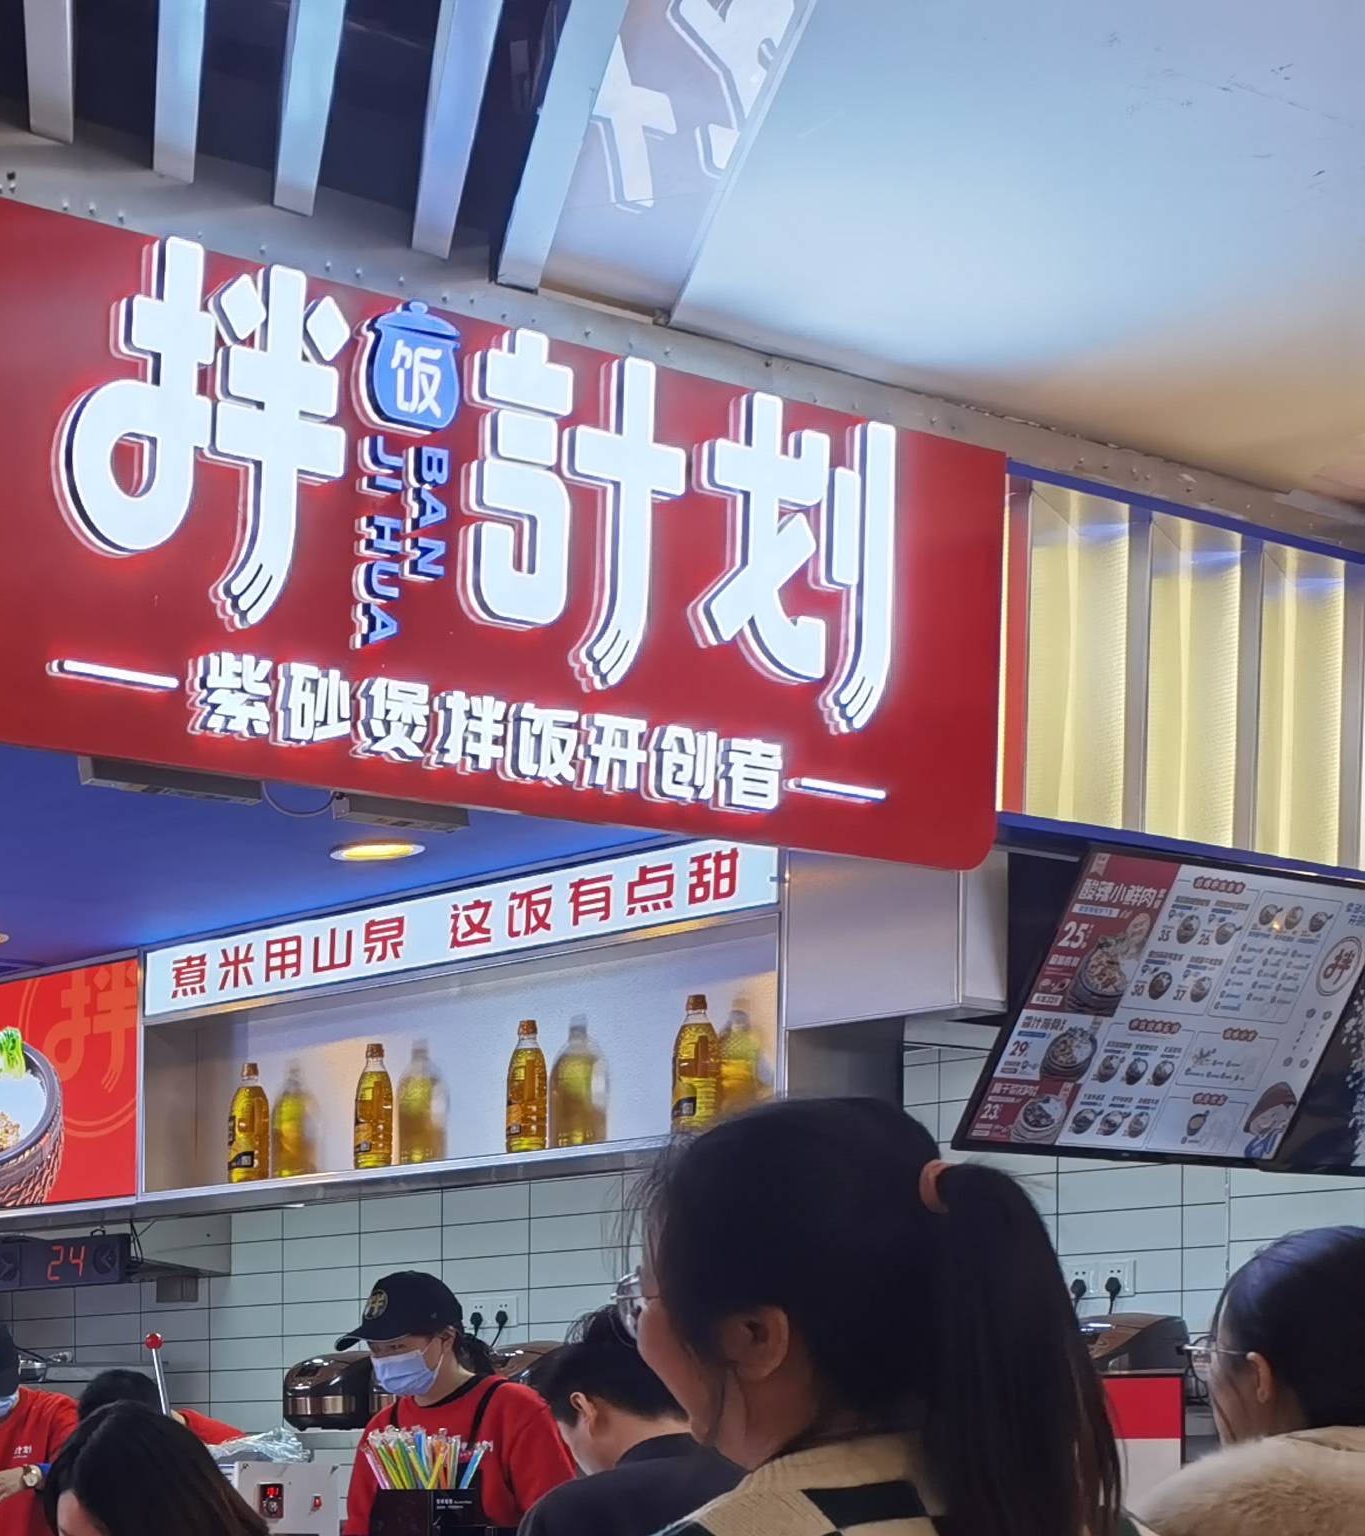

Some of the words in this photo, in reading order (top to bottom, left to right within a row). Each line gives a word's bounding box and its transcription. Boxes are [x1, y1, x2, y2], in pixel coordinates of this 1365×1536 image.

[406, 446, 445, 580] BAN
[191, 651, 784, 813] 紫砂煲拌饭开创者
[171, 914, 406, 999] 煮米用山泉
[449, 847, 740, 950] 这饭有点甜
[47, 1245, 85, 1282] 24
